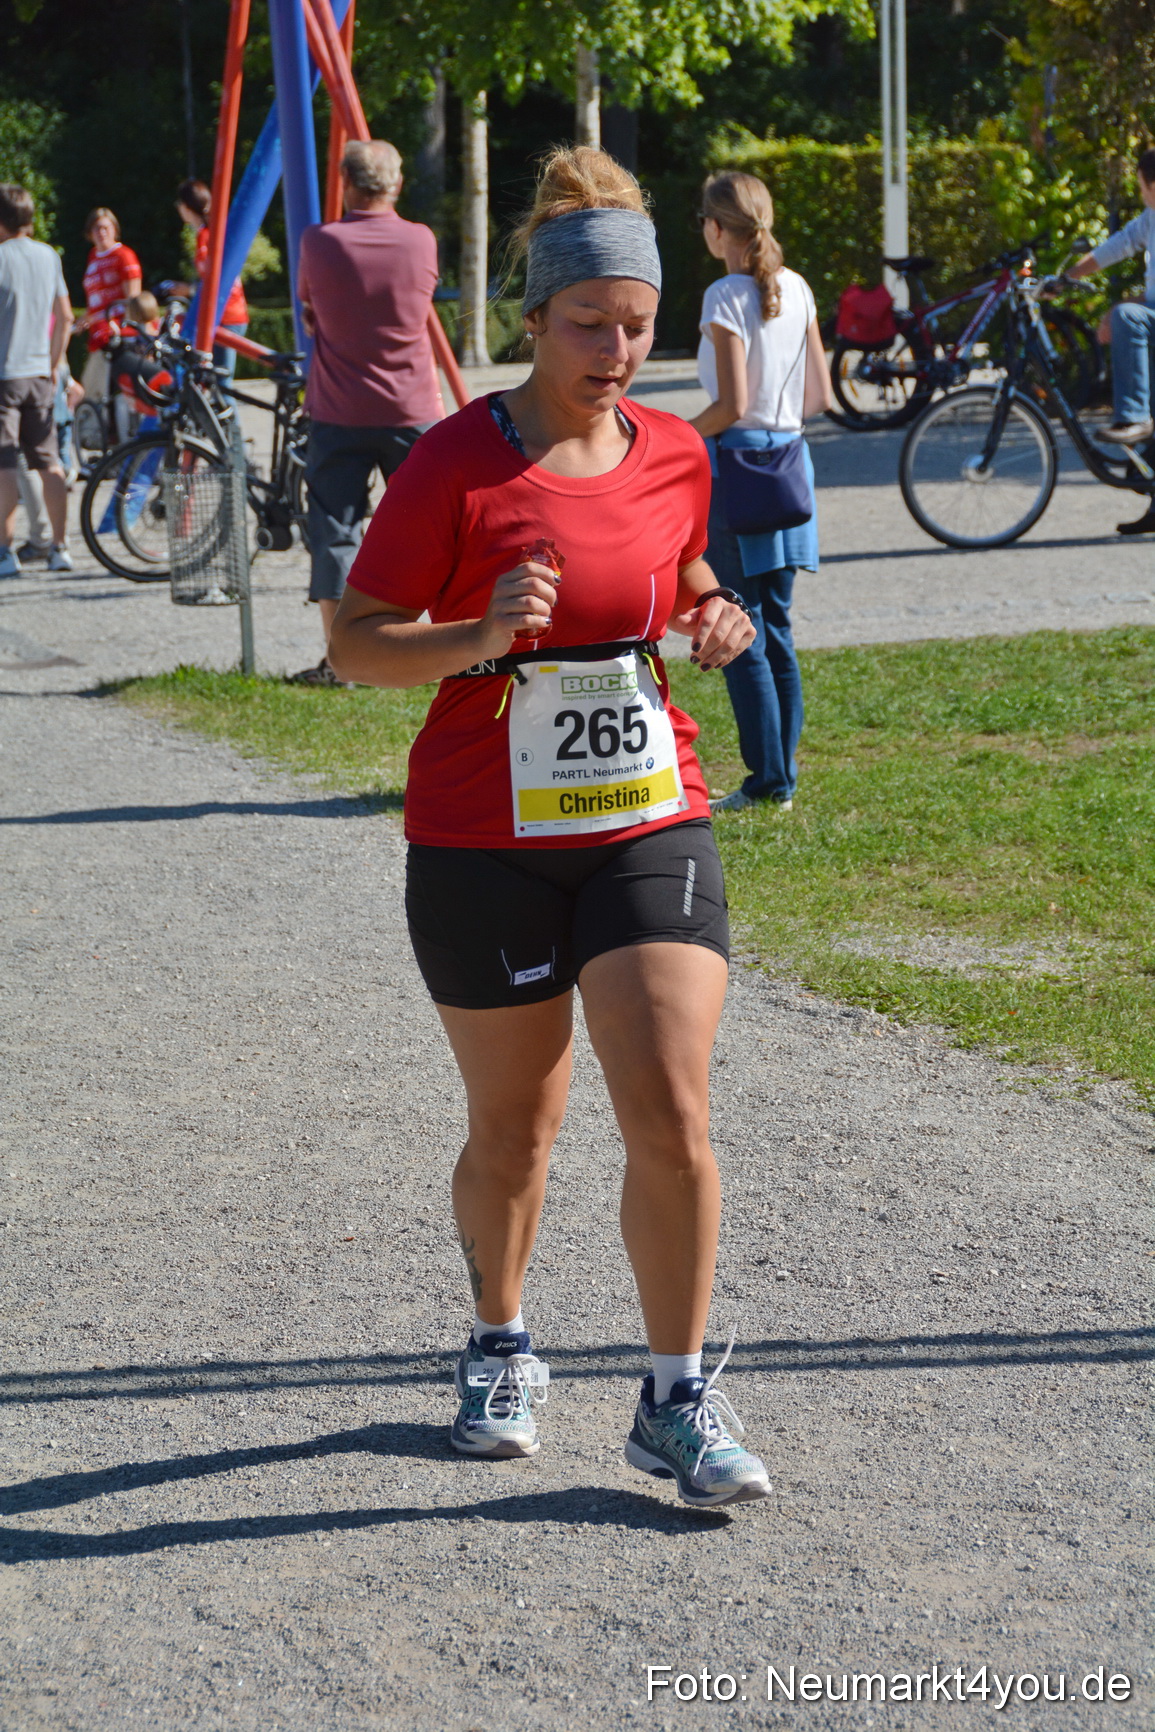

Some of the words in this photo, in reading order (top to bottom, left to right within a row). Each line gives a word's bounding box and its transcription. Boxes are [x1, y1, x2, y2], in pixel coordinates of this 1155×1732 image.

[561, 671, 638, 694] BOCK
[588, 693, 596, 701] by
[597, 691, 616, 699] smart
[554, 703, 648, 761] 265
[521, 752, 528, 762] B
[552, 767, 591, 780] PARTL
[593, 762, 643, 777] Neumarkt
[559, 787, 650, 814] Christina
